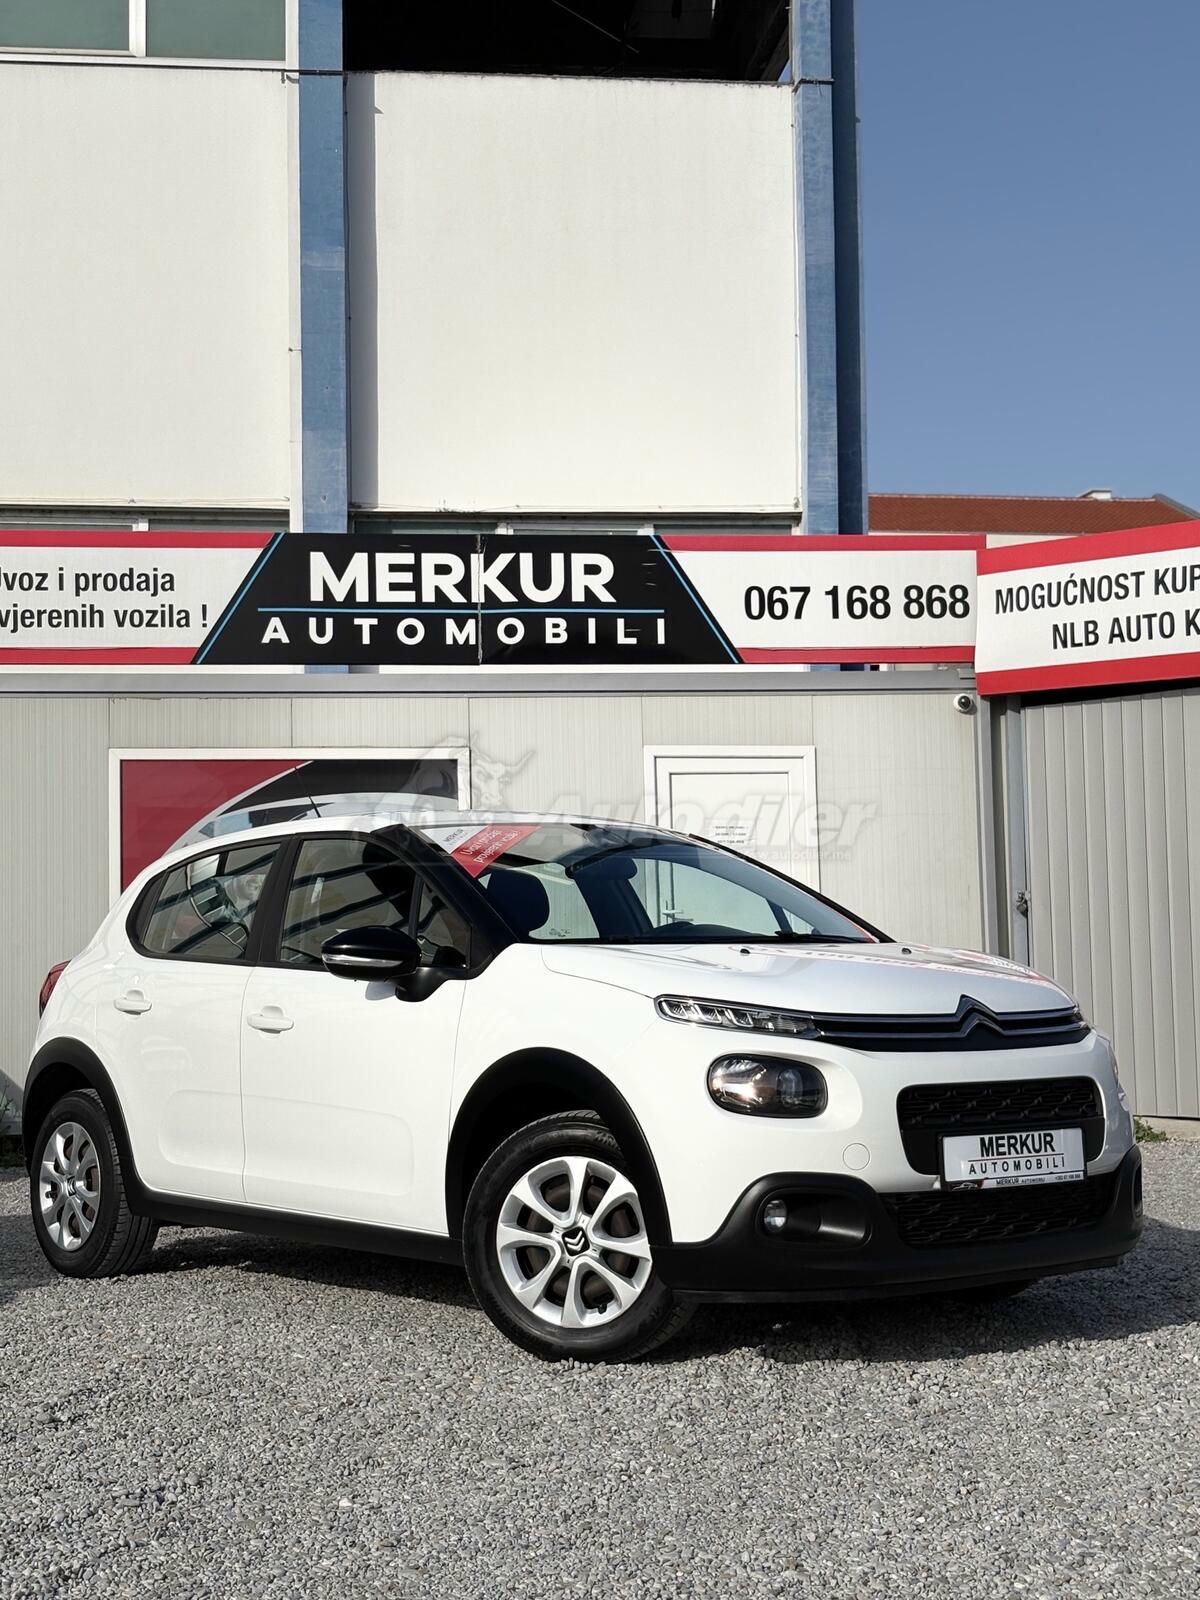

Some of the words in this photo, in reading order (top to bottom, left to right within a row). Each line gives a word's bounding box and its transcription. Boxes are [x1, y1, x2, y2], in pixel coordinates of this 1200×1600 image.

[0, 566, 49, 592] voz
[58, 566, 65, 591] i
[74, 567, 175, 597] prodaja
[309, 551, 617, 603] MERKUR
[744, 585, 811, 620] 067
[824, 584, 892, 620] 168
[903, 583, 971, 620] 868
[994, 571, 1145, 615] MOGUĆNOST
[113, 603, 191, 628] vozila
[201, 603, 208, 628] !
[261, 616, 667, 646] AUTOMOBILI
[1051, 619, 1100, 650] NLB
[1108, 611, 1176, 645] AUTO
[979, 1132, 1056, 1158] MERKUR
[968, 1156, 1065, 1175] AUTOMOBILI
